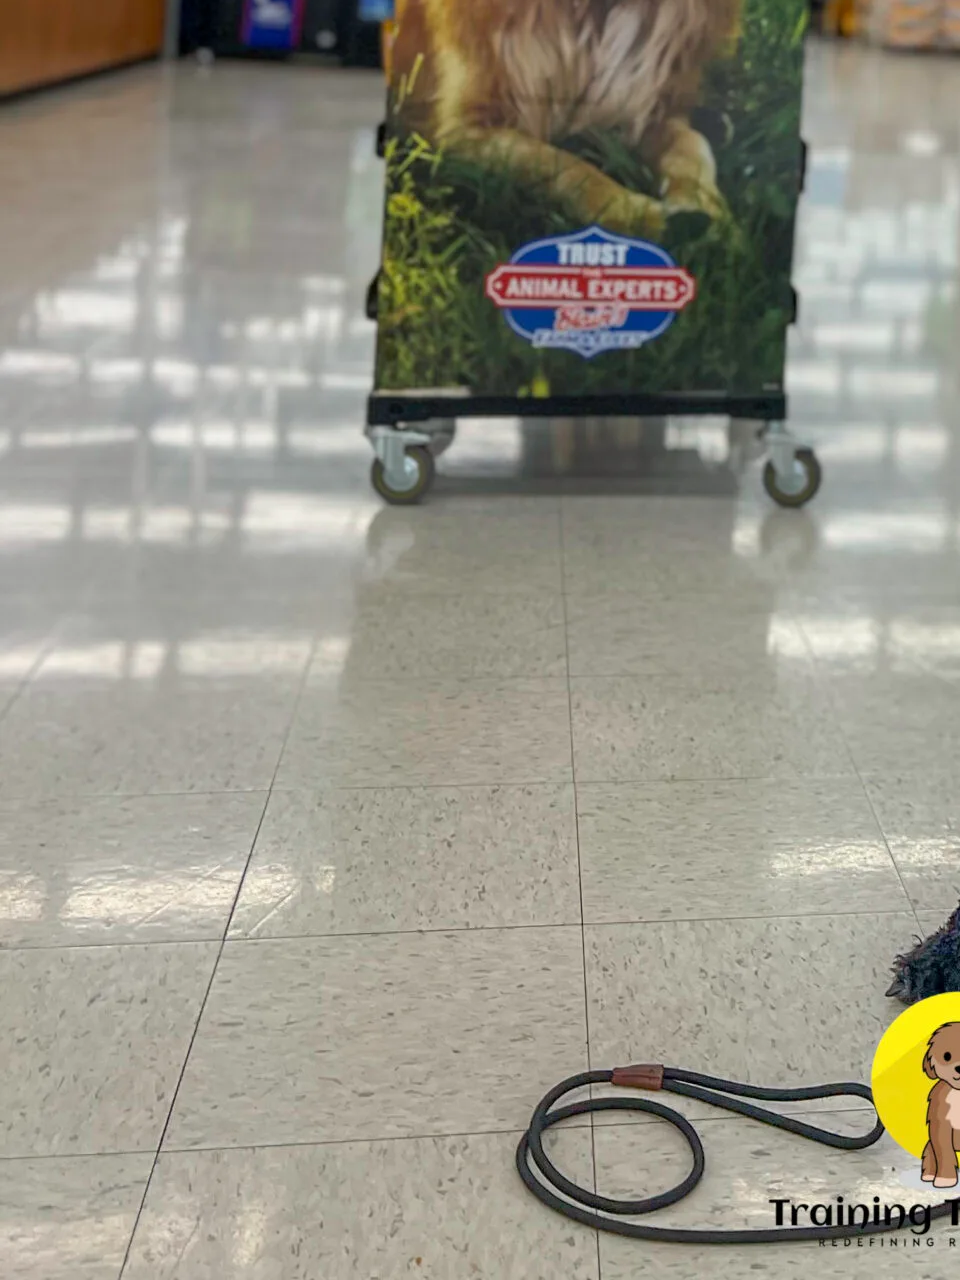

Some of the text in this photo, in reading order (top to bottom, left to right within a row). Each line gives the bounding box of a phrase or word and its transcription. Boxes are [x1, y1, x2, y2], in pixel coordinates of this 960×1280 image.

[557, 242, 629, 266] TRUST
[505, 277, 678, 301] ANIMAL EXPERTS
